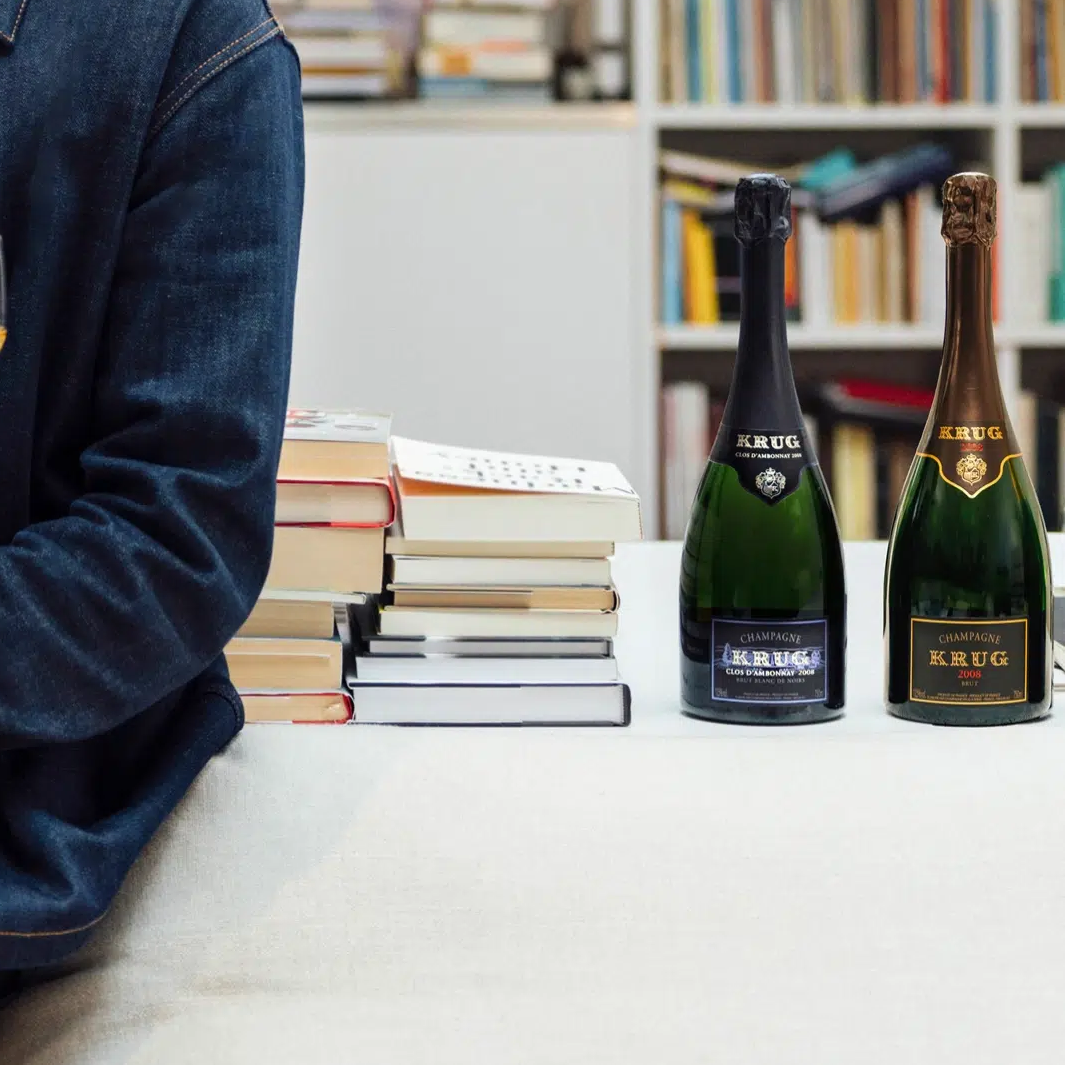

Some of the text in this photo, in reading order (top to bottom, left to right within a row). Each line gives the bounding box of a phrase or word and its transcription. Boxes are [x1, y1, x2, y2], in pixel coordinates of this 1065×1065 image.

[938, 425, 1004, 441] KRUG
[736, 433, 801, 450] KRUG
[740, 631, 802, 645] CHAMPAGNE
[939, 631, 1001, 645] CHAMPAGNE
[731, 649, 809, 667] KRUG
[929, 649, 1010, 667] KRUG
[725, 668, 744, 676] CLOS
[746, 668, 795, 677] D'AMBONNAY
[957, 669, 982, 679] 2008
